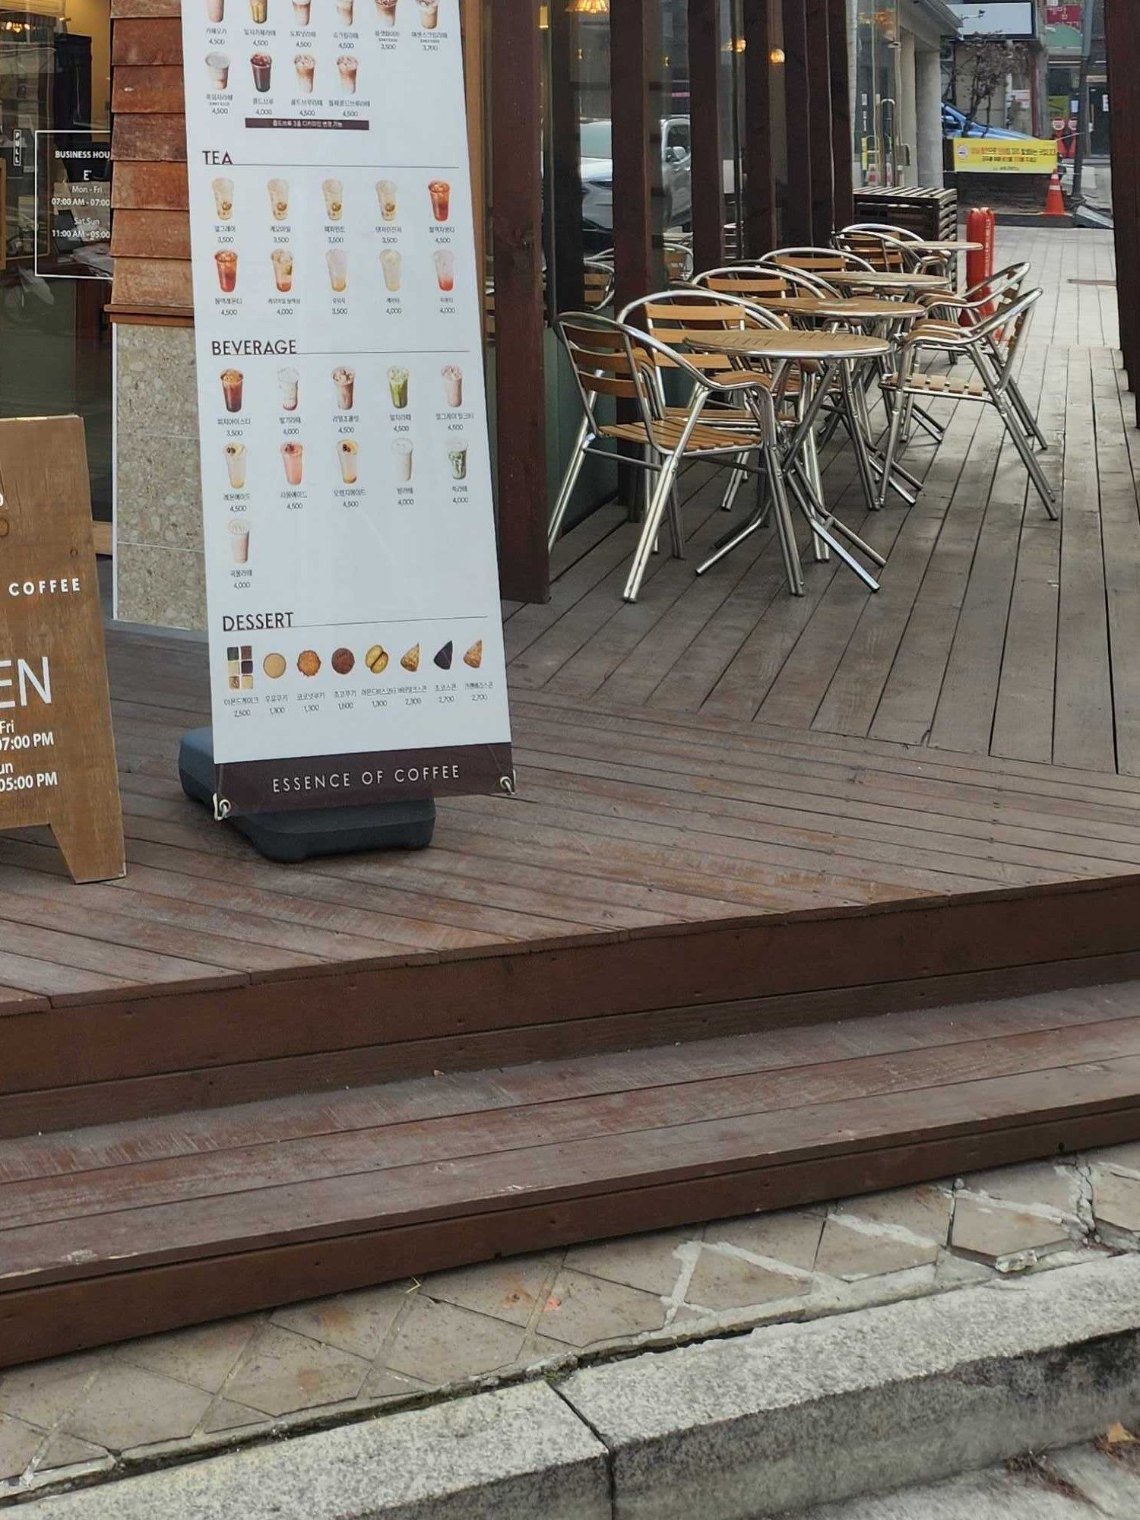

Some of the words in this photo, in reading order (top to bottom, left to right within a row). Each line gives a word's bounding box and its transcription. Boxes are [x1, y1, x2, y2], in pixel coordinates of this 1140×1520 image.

[55, 150, 91, 159] BUSINESS
[202, 150, 233, 165] TEA
[72, 185, 88, 193] Mon
[93, 185, 103, 193] Fri
[51, 198, 71, 206] 07:00
[72, 198, 85, 206] AM
[90, 198, 110, 206] 07:00
[72, 230, 85, 238] AM
[211, 340, 297, 356] BEVERAGE
[9, 578, 81, 598] COFFEE
[223, 612, 295, 631] DESSERT
[234, 709, 251, 717] 2,500
[0, 721, 15, 736] Fri
[34, 732, 54, 747] PM
[35, 771, 58, 787] PM
[273, 772, 350, 792] ESSENCE
[361, 769, 383, 785] OF
[394, 765, 460, 783] COFFEE
